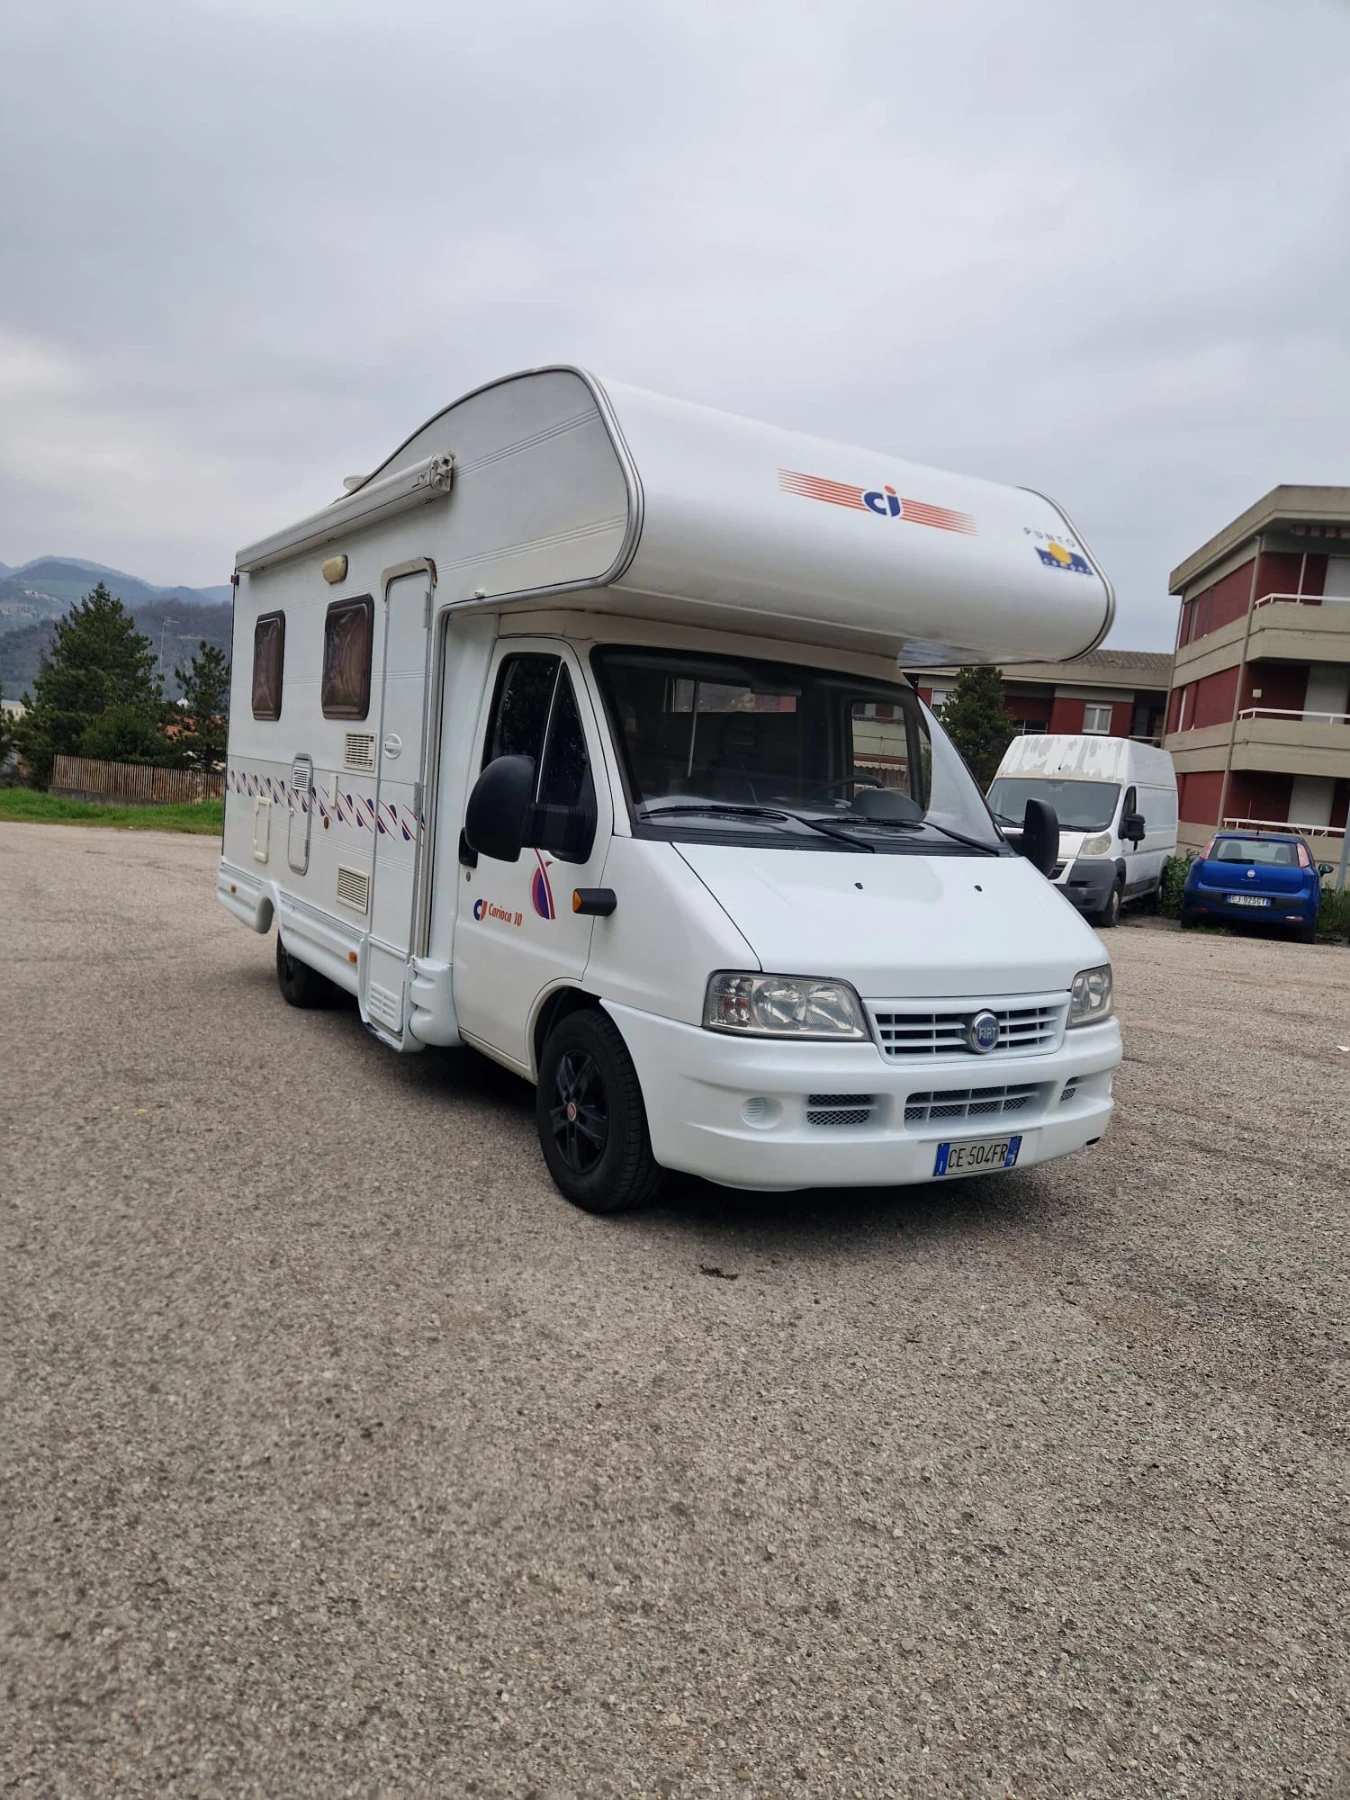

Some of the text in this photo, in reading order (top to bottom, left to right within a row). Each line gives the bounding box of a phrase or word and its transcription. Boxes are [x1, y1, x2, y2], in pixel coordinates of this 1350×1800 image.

[488, 903, 512, 923] Carioca
[513, 911, 523, 927] 10
[978, 1026, 997, 1040] FIAT
[948, 1148, 966, 1168] CE
[967, 1143, 1009, 1166] 504FR
